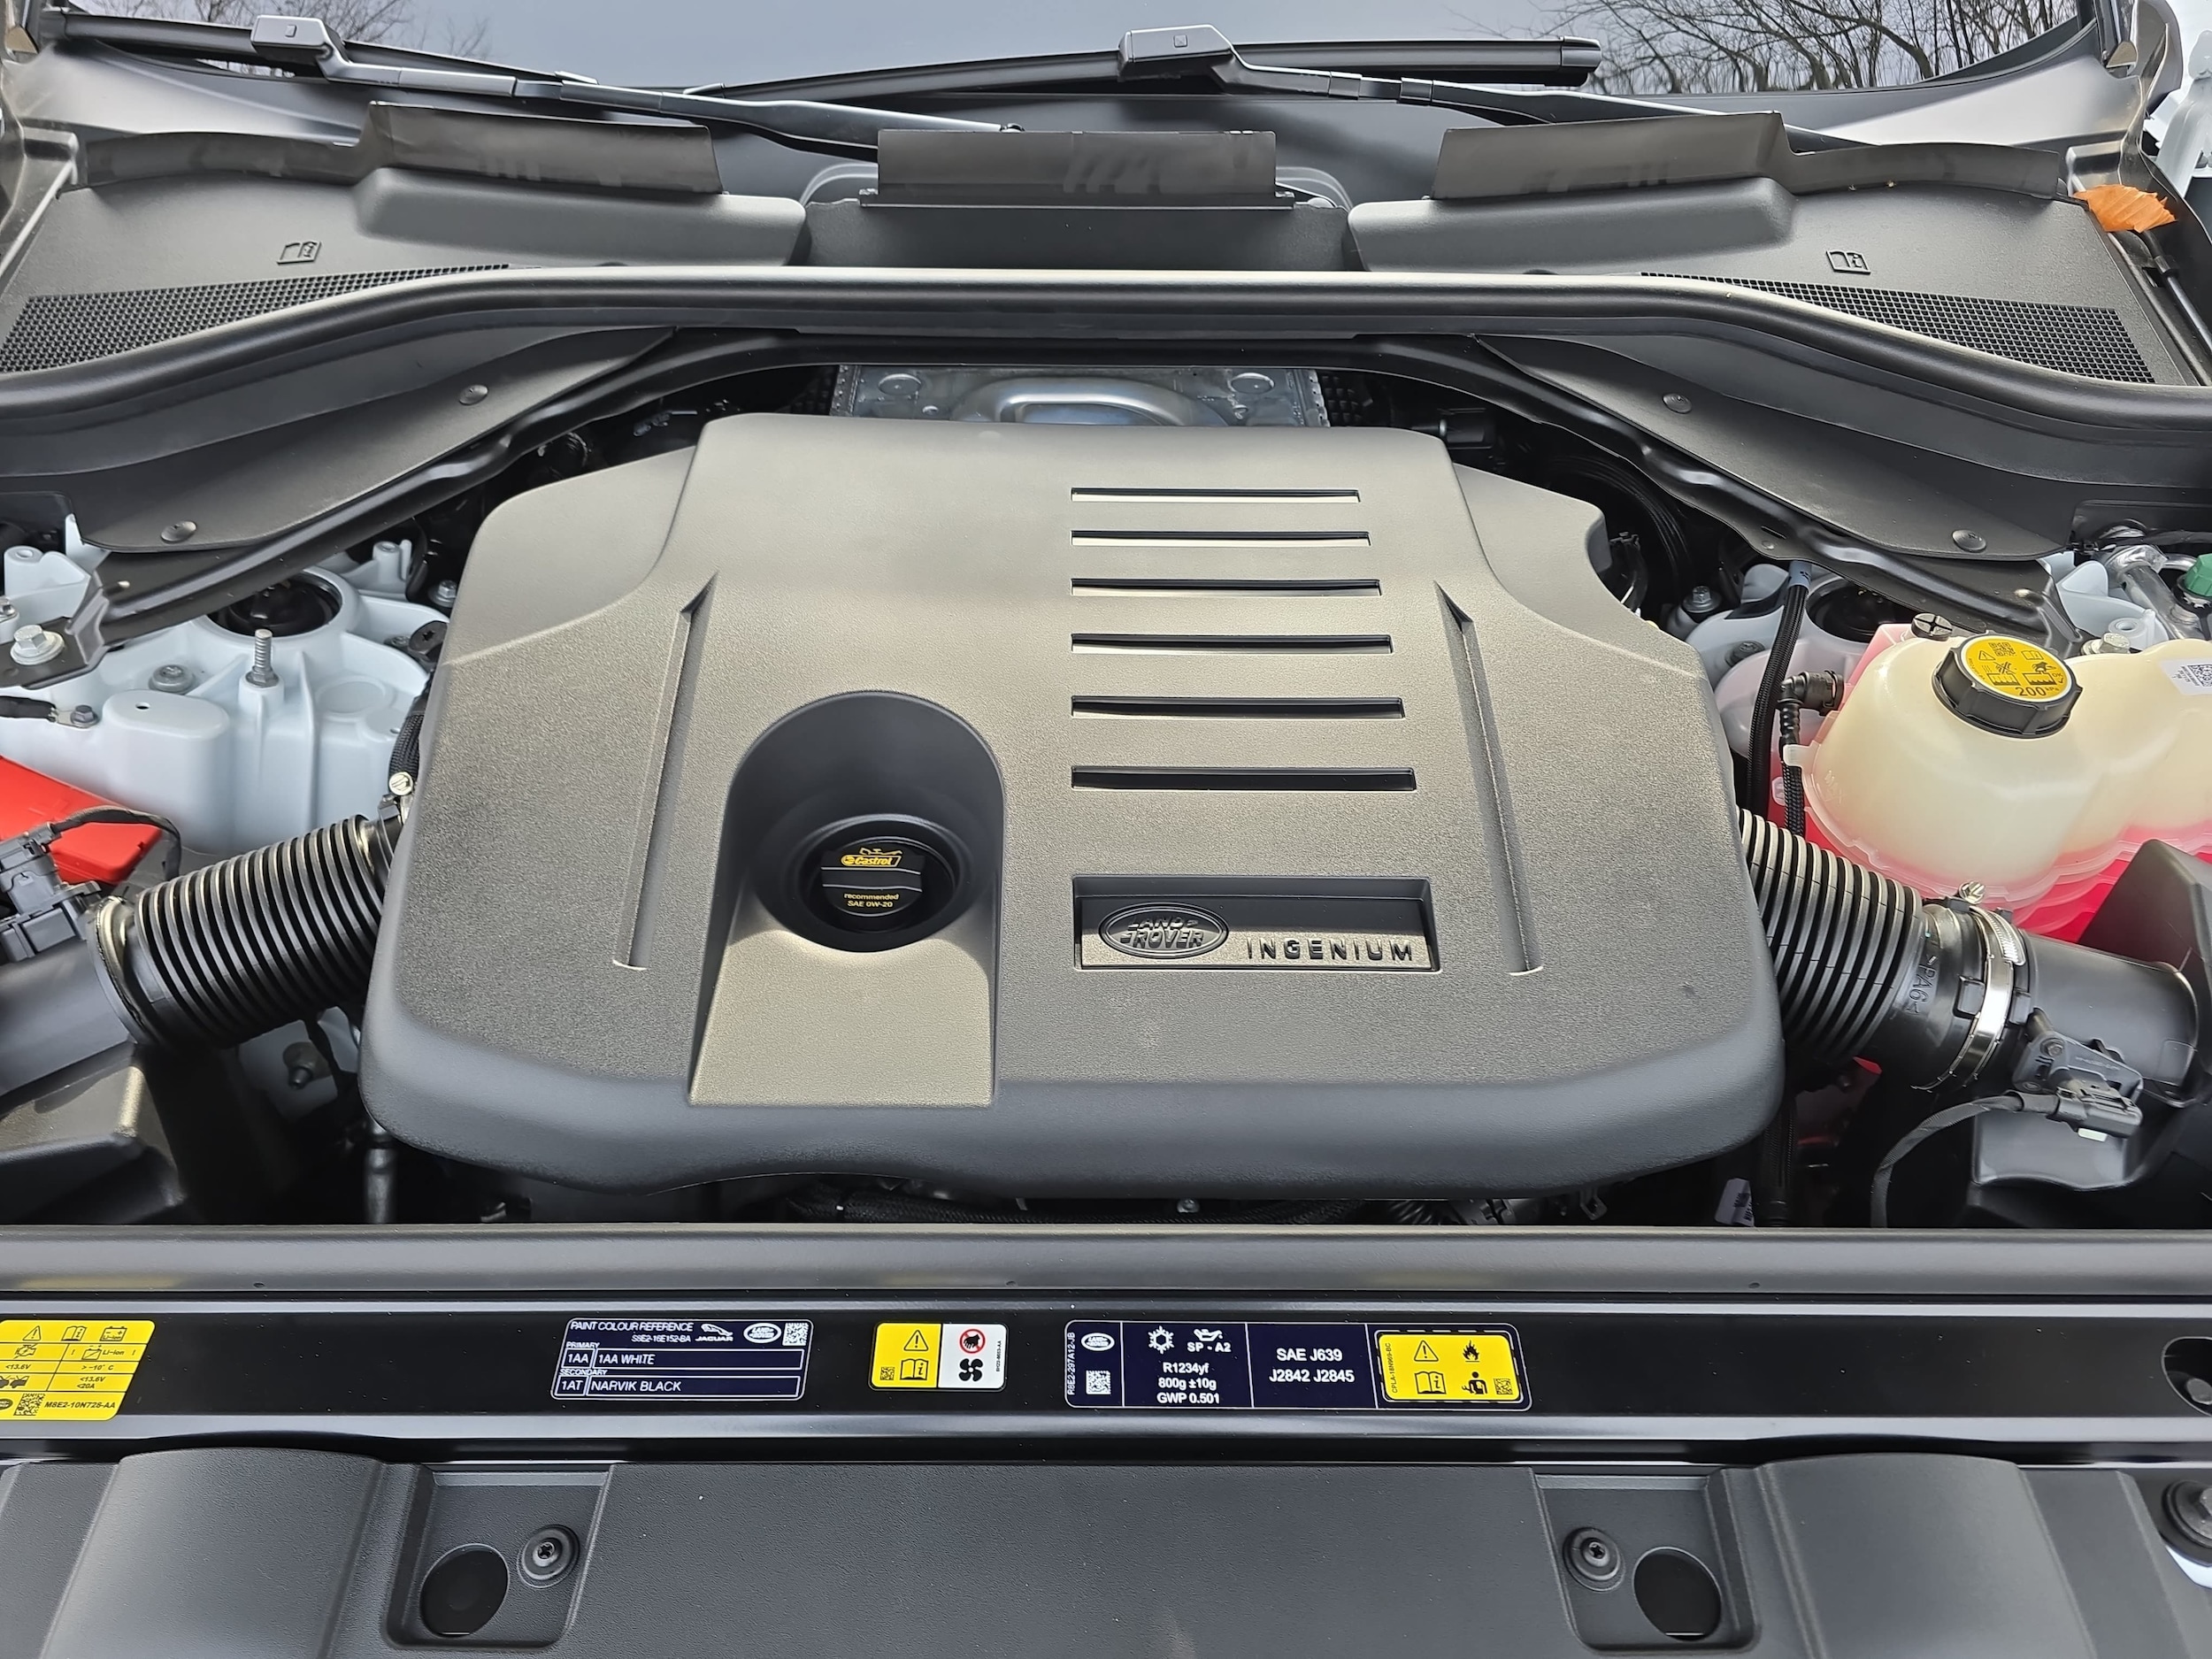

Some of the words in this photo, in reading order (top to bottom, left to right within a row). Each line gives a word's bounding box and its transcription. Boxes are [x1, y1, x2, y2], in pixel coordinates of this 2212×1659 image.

[2016, 687, 2047, 696] 200
[855, 856, 892, 865] Castrol
[1133, 930, 1203, 949] ROVER
[1247, 937, 1413, 961] INGENIUM
[571, 1321, 597, 1330] PAINT
[598, 1321, 638, 1332] COLOUR
[639, 1321, 695, 1332] REFERENCE
[1187, 1342, 1203, 1352] SP
[1215, 1343, 1231, 1353] A2
[567, 1354, 588, 1363] 1AA
[599, 1354, 618, 1363] 1AA
[620, 1354, 656, 1364] WHITE
[1276, 1348, 1307, 1362] SAE
[1310, 1348, 1342, 1362] J639
[1163, 1363, 1210, 1375] R1234yf
[1269, 1369, 1310, 1382] J2842
[1313, 1369, 1355, 1382] J2845
[562, 1380, 583, 1391] 1AT
[591, 1381, 637, 1392] NARVIK
[640, 1381, 681, 1392] BLACK
[1158, 1378, 1187, 1390] 800g
[1188, 1379, 1217, 1390] ±10g
[1156, 1393, 1187, 1404] GWP
[1189, 1393, 1220, 1404] 0.501
